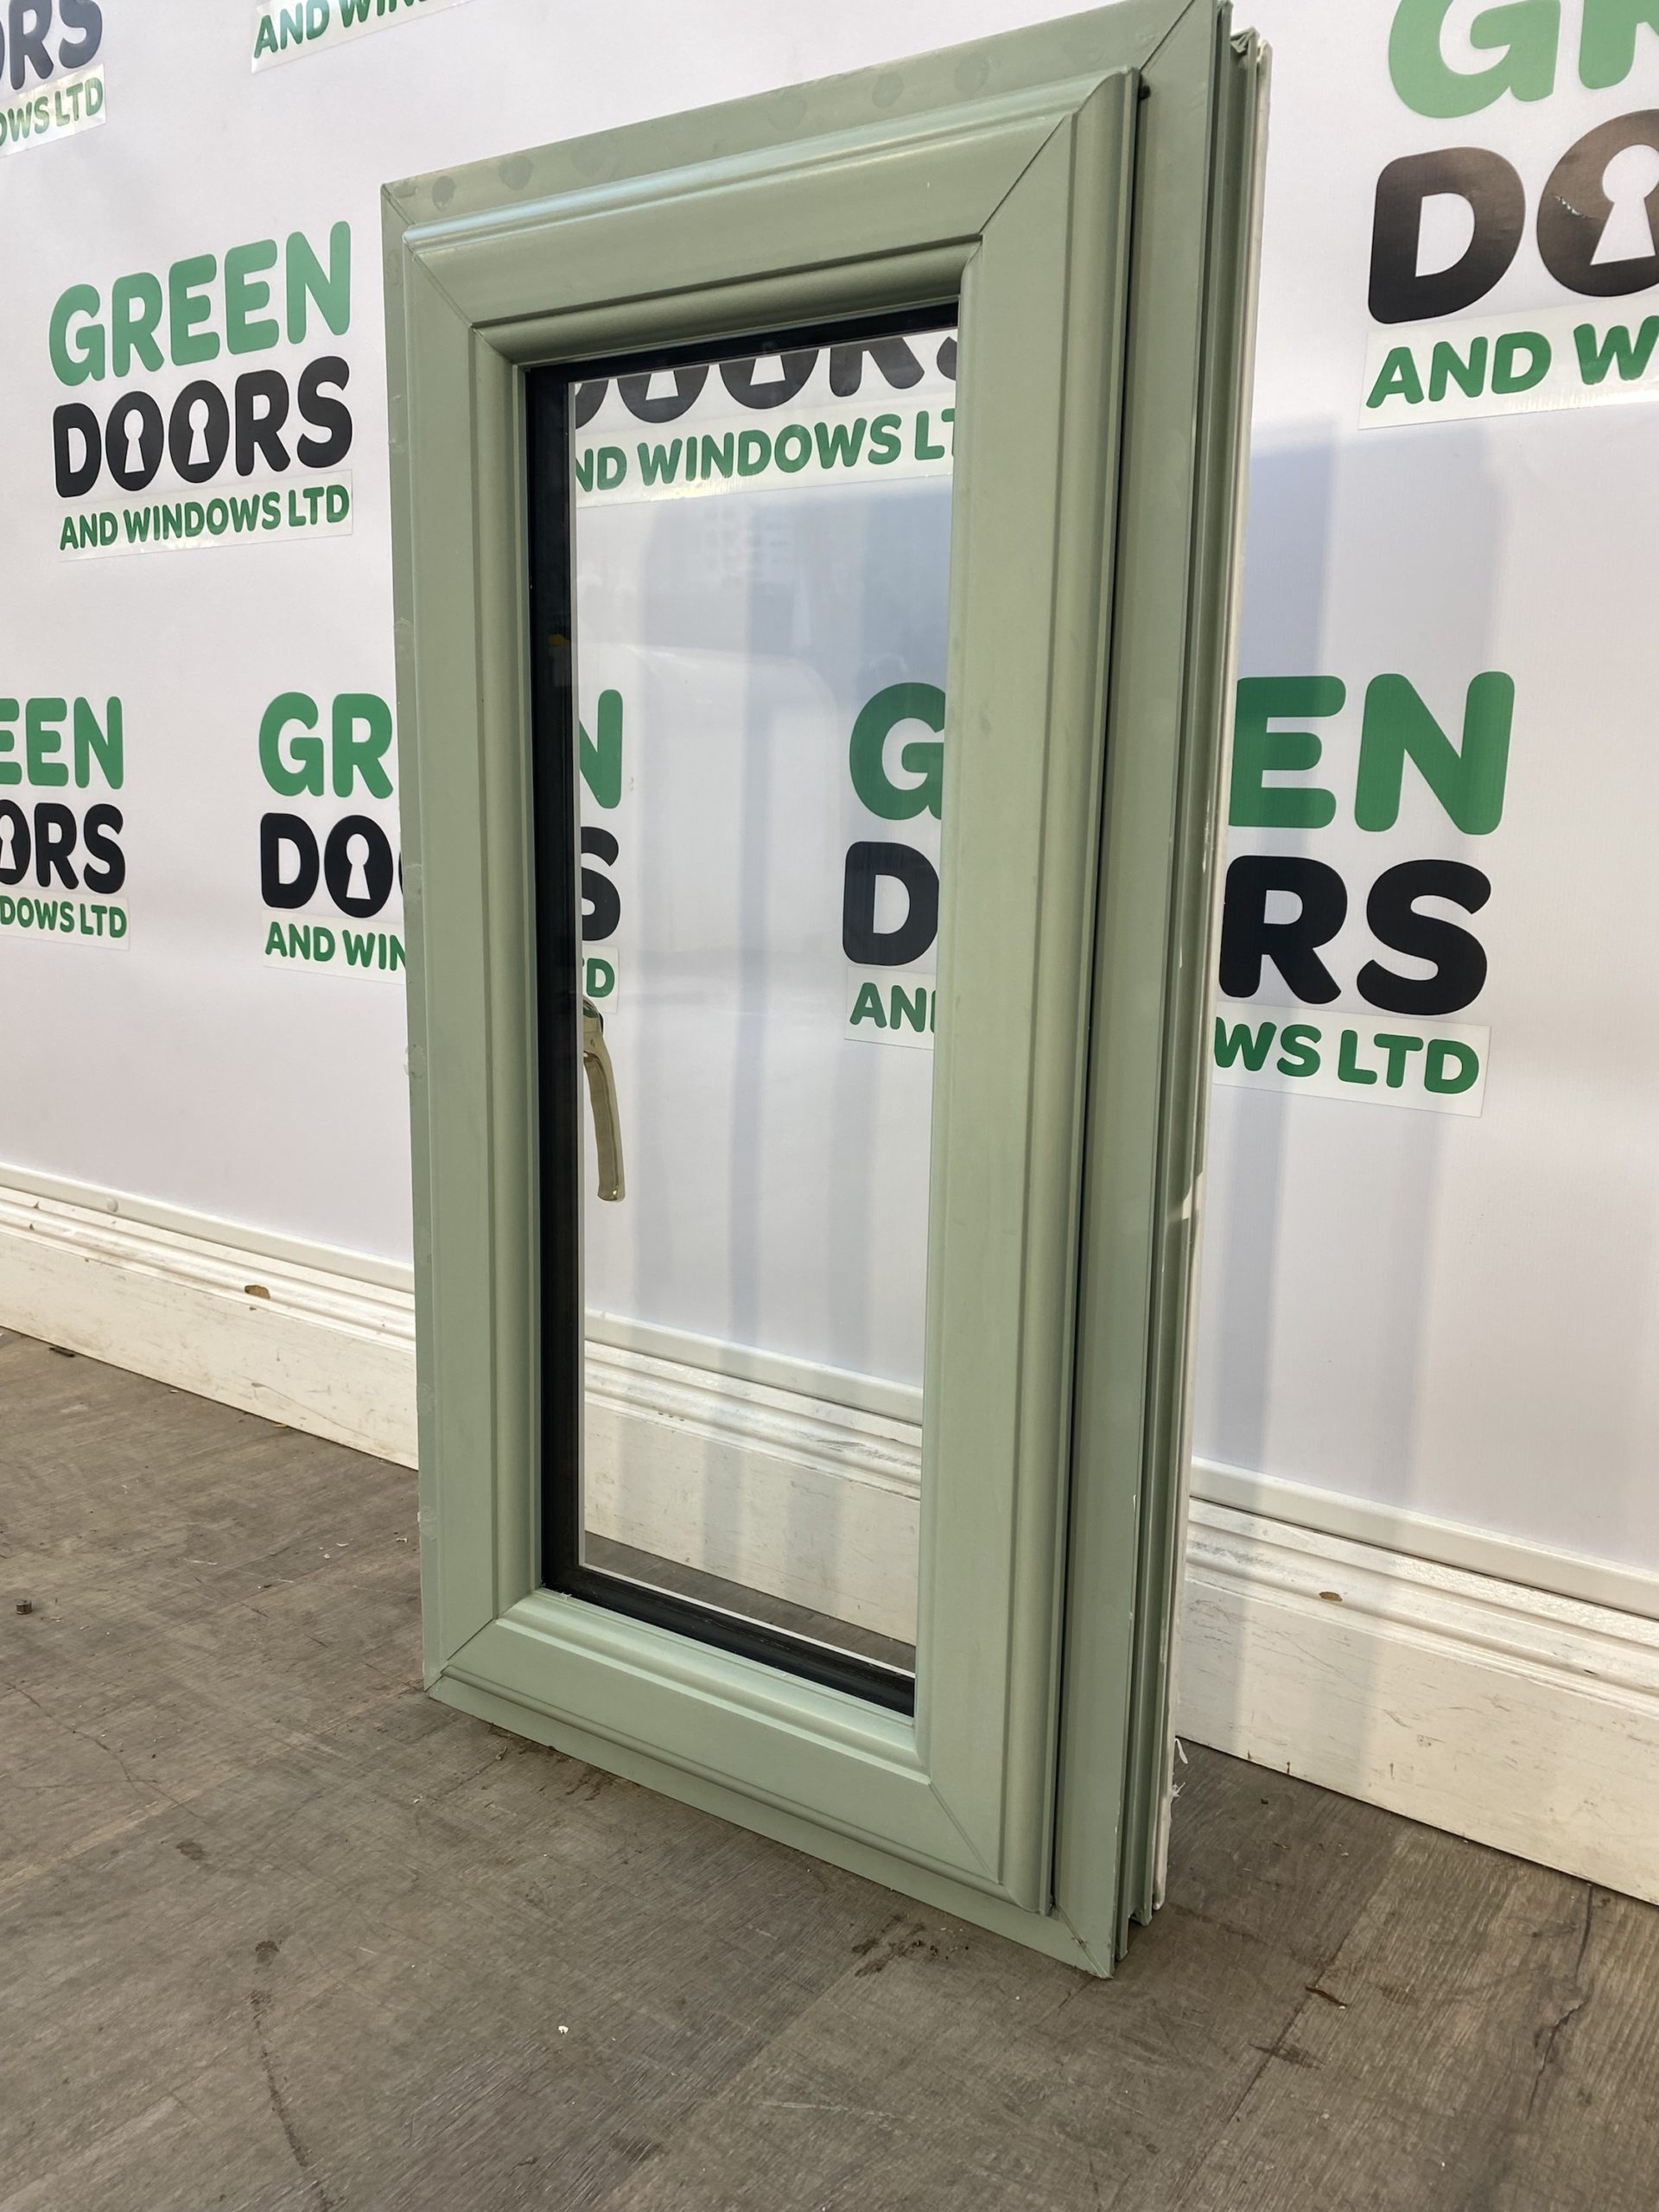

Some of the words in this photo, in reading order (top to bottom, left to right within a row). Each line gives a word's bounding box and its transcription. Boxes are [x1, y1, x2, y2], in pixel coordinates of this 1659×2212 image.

[254, 0, 330, 59] AND
[54, 77, 103, 127] LTD
[48, 220, 352, 386] GREEN
[1366, 331, 1553, 409] AND
[52, 355, 353, 499] DOORS
[575, 446, 626, 492] ND
[637, 414, 902, 486] WINDOWS
[60, 512, 118, 550] AND
[124, 492, 281, 543] WINDOWS
[288, 484, 350, 526] LTD
[0, 798, 126, 895] ORS
[0, 895, 75, 932] DOWS
[79, 903, 127, 938] LTD
[264, 921, 335, 962] AND
[849, 982, 937, 1033] AN
[1338, 1029, 1480, 1095] LTD
